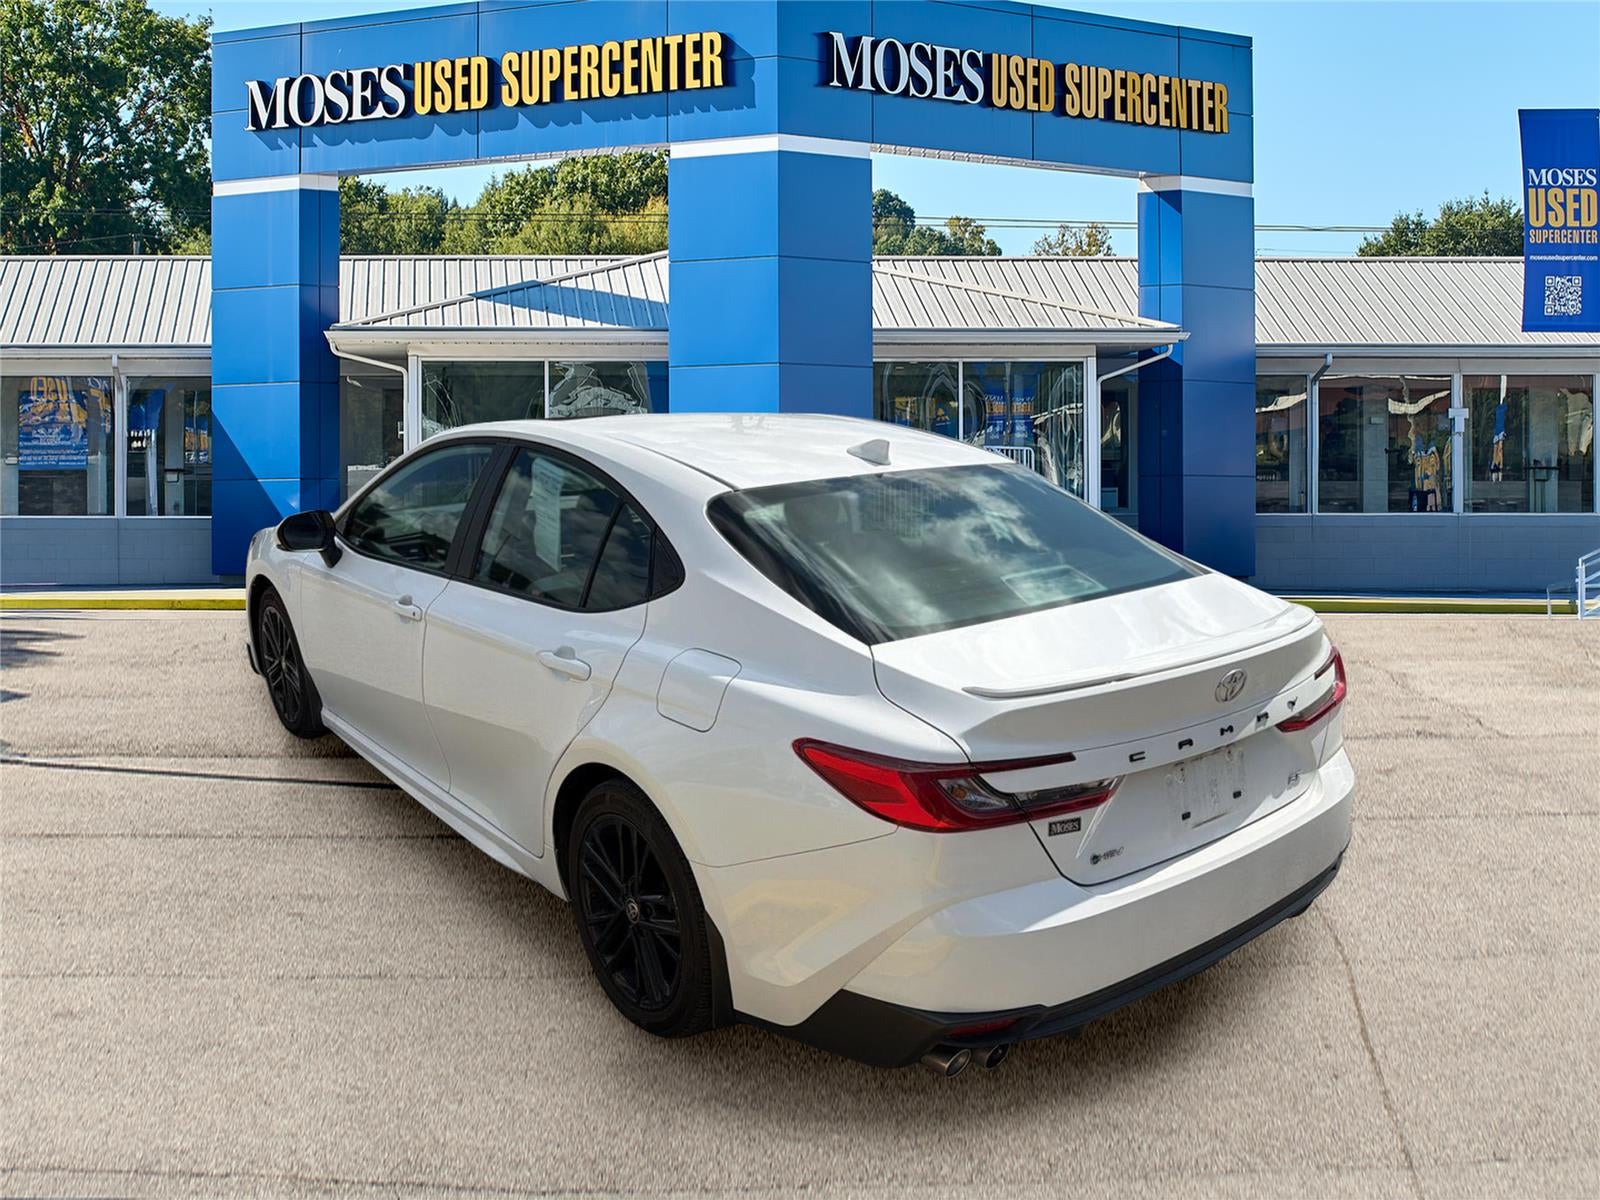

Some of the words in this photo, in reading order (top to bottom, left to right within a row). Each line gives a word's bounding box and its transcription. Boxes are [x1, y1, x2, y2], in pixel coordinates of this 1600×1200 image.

[244, 65, 406, 131] MOSES
[414, 56, 488, 115] USED
[501, 31, 723, 108] SUPERCENTER
[829, 32, 984, 104] MOSES
[990, 52, 1056, 113] USED
[1063, 62, 1229, 134] SUPERCENTER
[1528, 168, 1597, 186] MOSES
[1529, 188, 1598, 227] USED
[1529, 229, 1598, 244] SUPERCENTER
[1128, 696, 1298, 763] CAMRY
